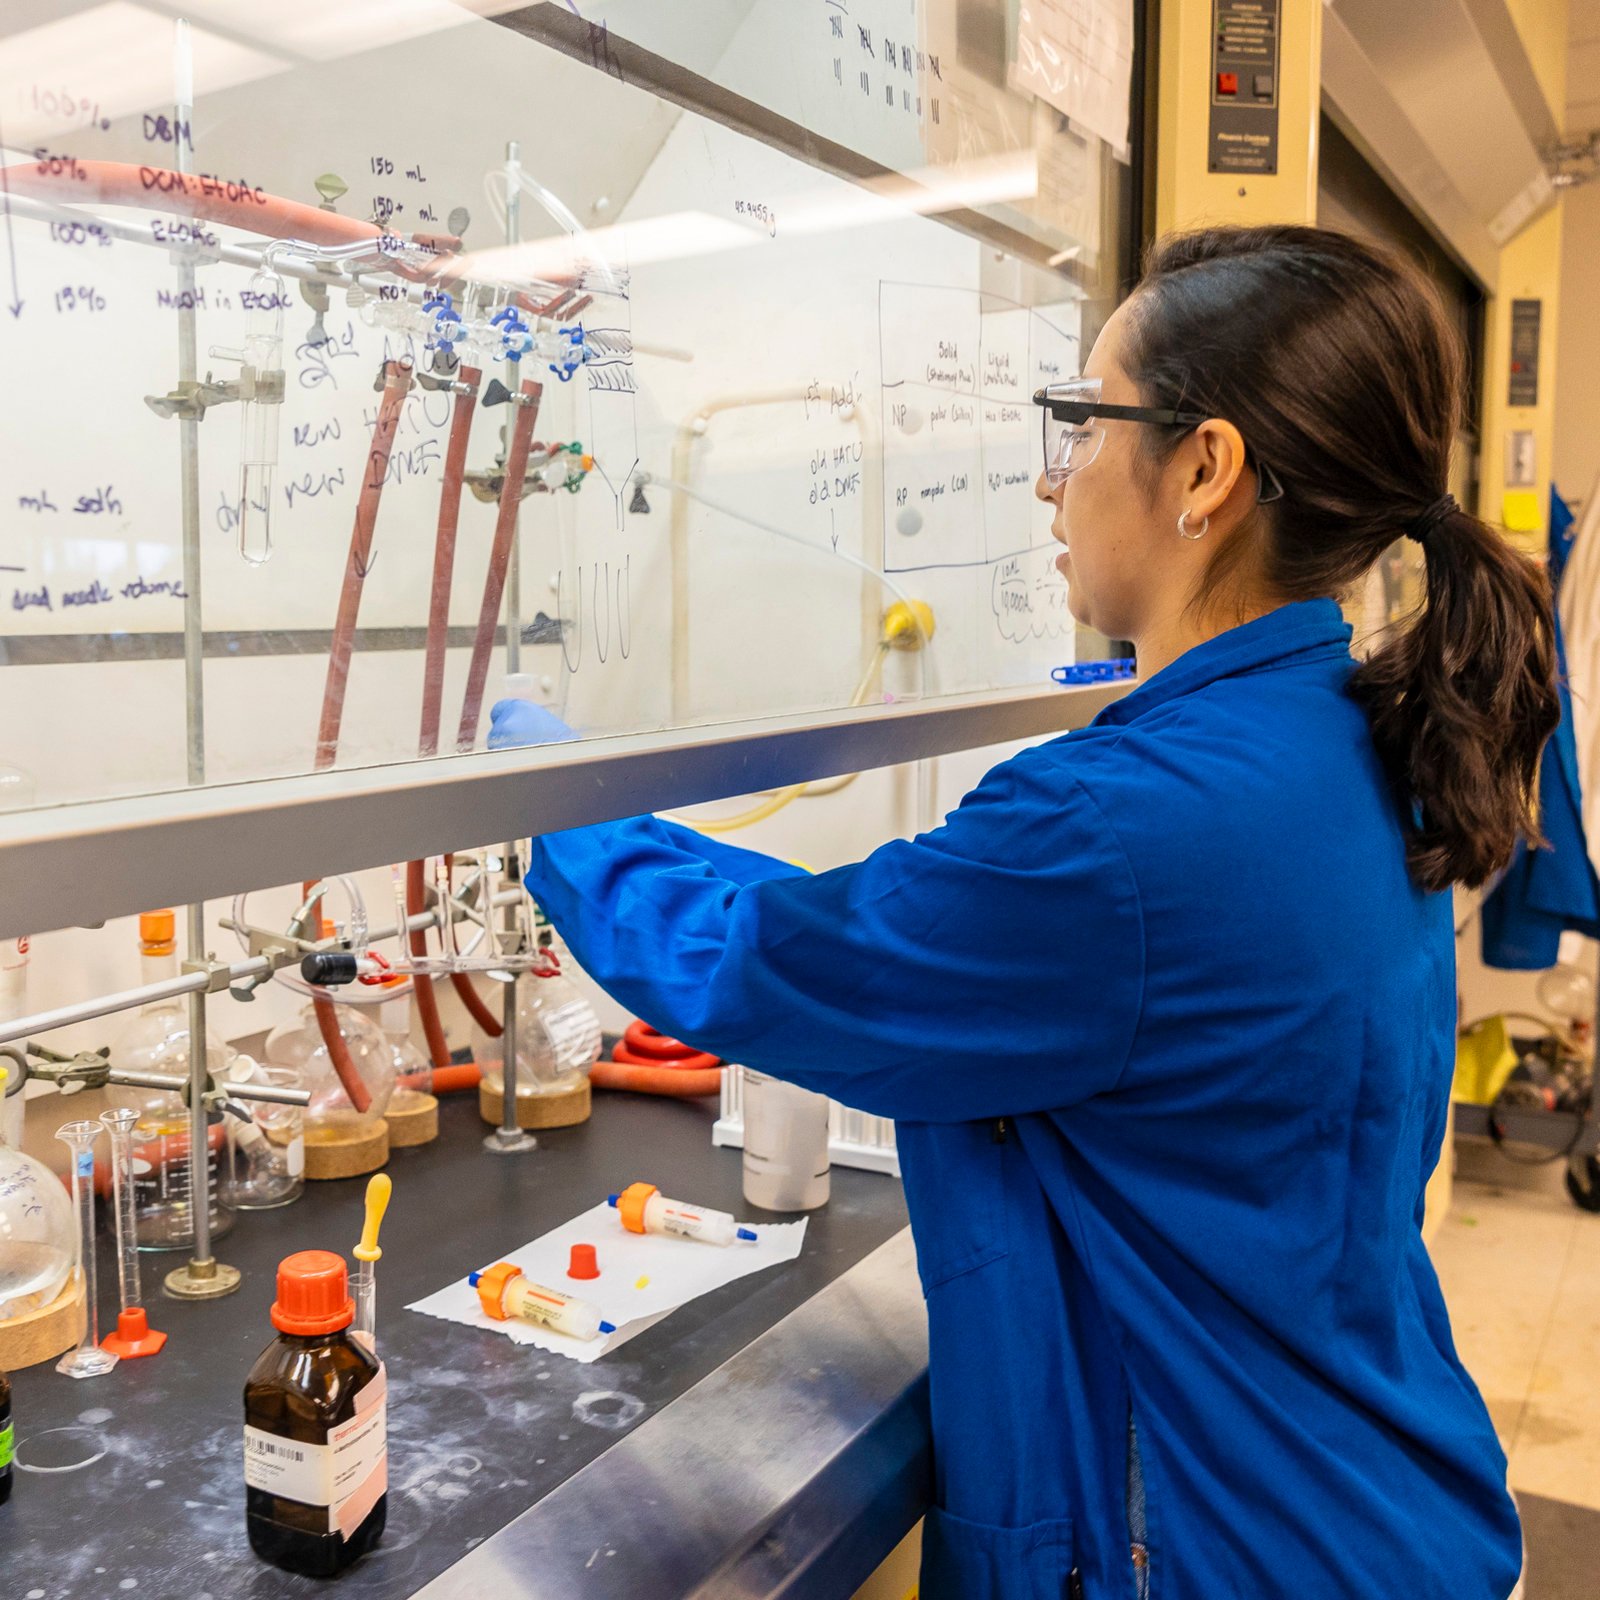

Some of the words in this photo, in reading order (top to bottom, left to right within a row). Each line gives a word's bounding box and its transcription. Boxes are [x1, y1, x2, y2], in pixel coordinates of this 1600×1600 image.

[406, 165, 426, 182] mL
[419, 204, 438, 222] mL
[420, 239, 441, 254] mL
[939, 340, 959, 363] Solid
[892, 403, 907, 427] NP
[285, 468, 345, 508] new
